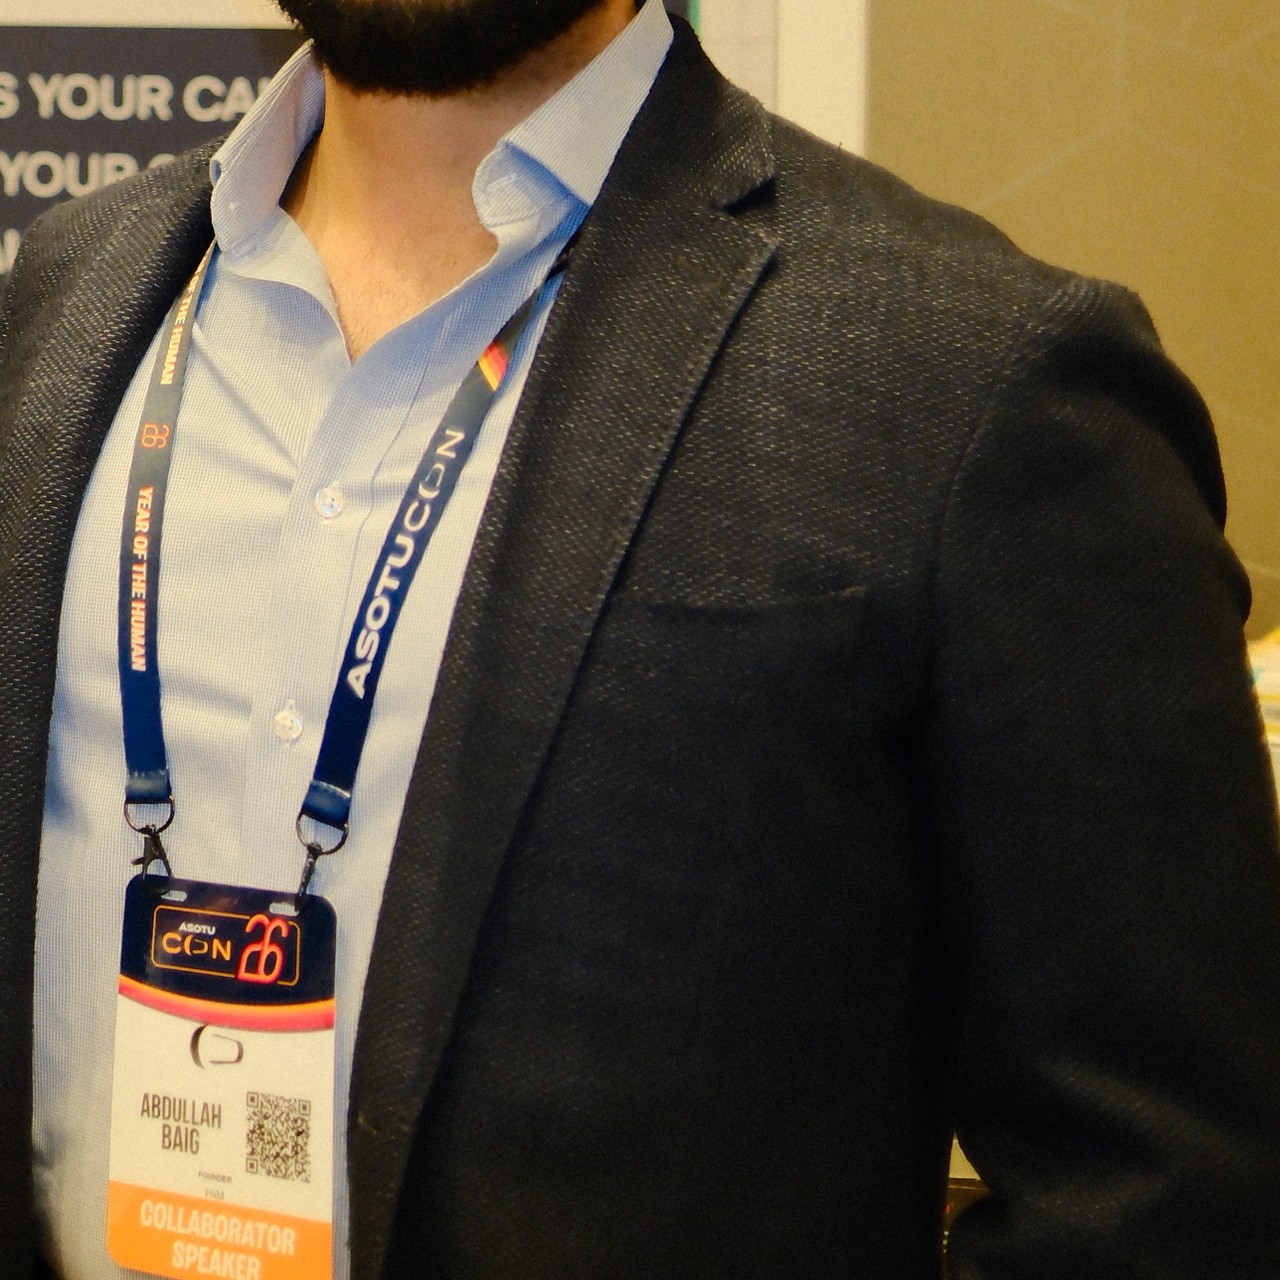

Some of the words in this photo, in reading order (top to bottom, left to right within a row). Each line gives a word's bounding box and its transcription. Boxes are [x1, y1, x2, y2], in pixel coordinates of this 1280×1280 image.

[30, 72, 175, 122] YOUR
[182, 75, 272, 122] CA
[174, 294, 192, 325] THE
[160, 325, 183, 385] HUMAN
[134, 485, 154, 533] YEAR
[132, 534, 149, 560] OF
[131, 562, 147, 600] THE
[130, 601, 147, 672] HUMAN
[178, 921, 217, 936] ASOTU
[140, 1092, 223, 1130] ABDULLAH
[161, 1123, 201, 1156] BAIG
[139, 1199, 297, 1257] COLLABORATOR
[170, 1240, 262, 1280] SPEAKER
